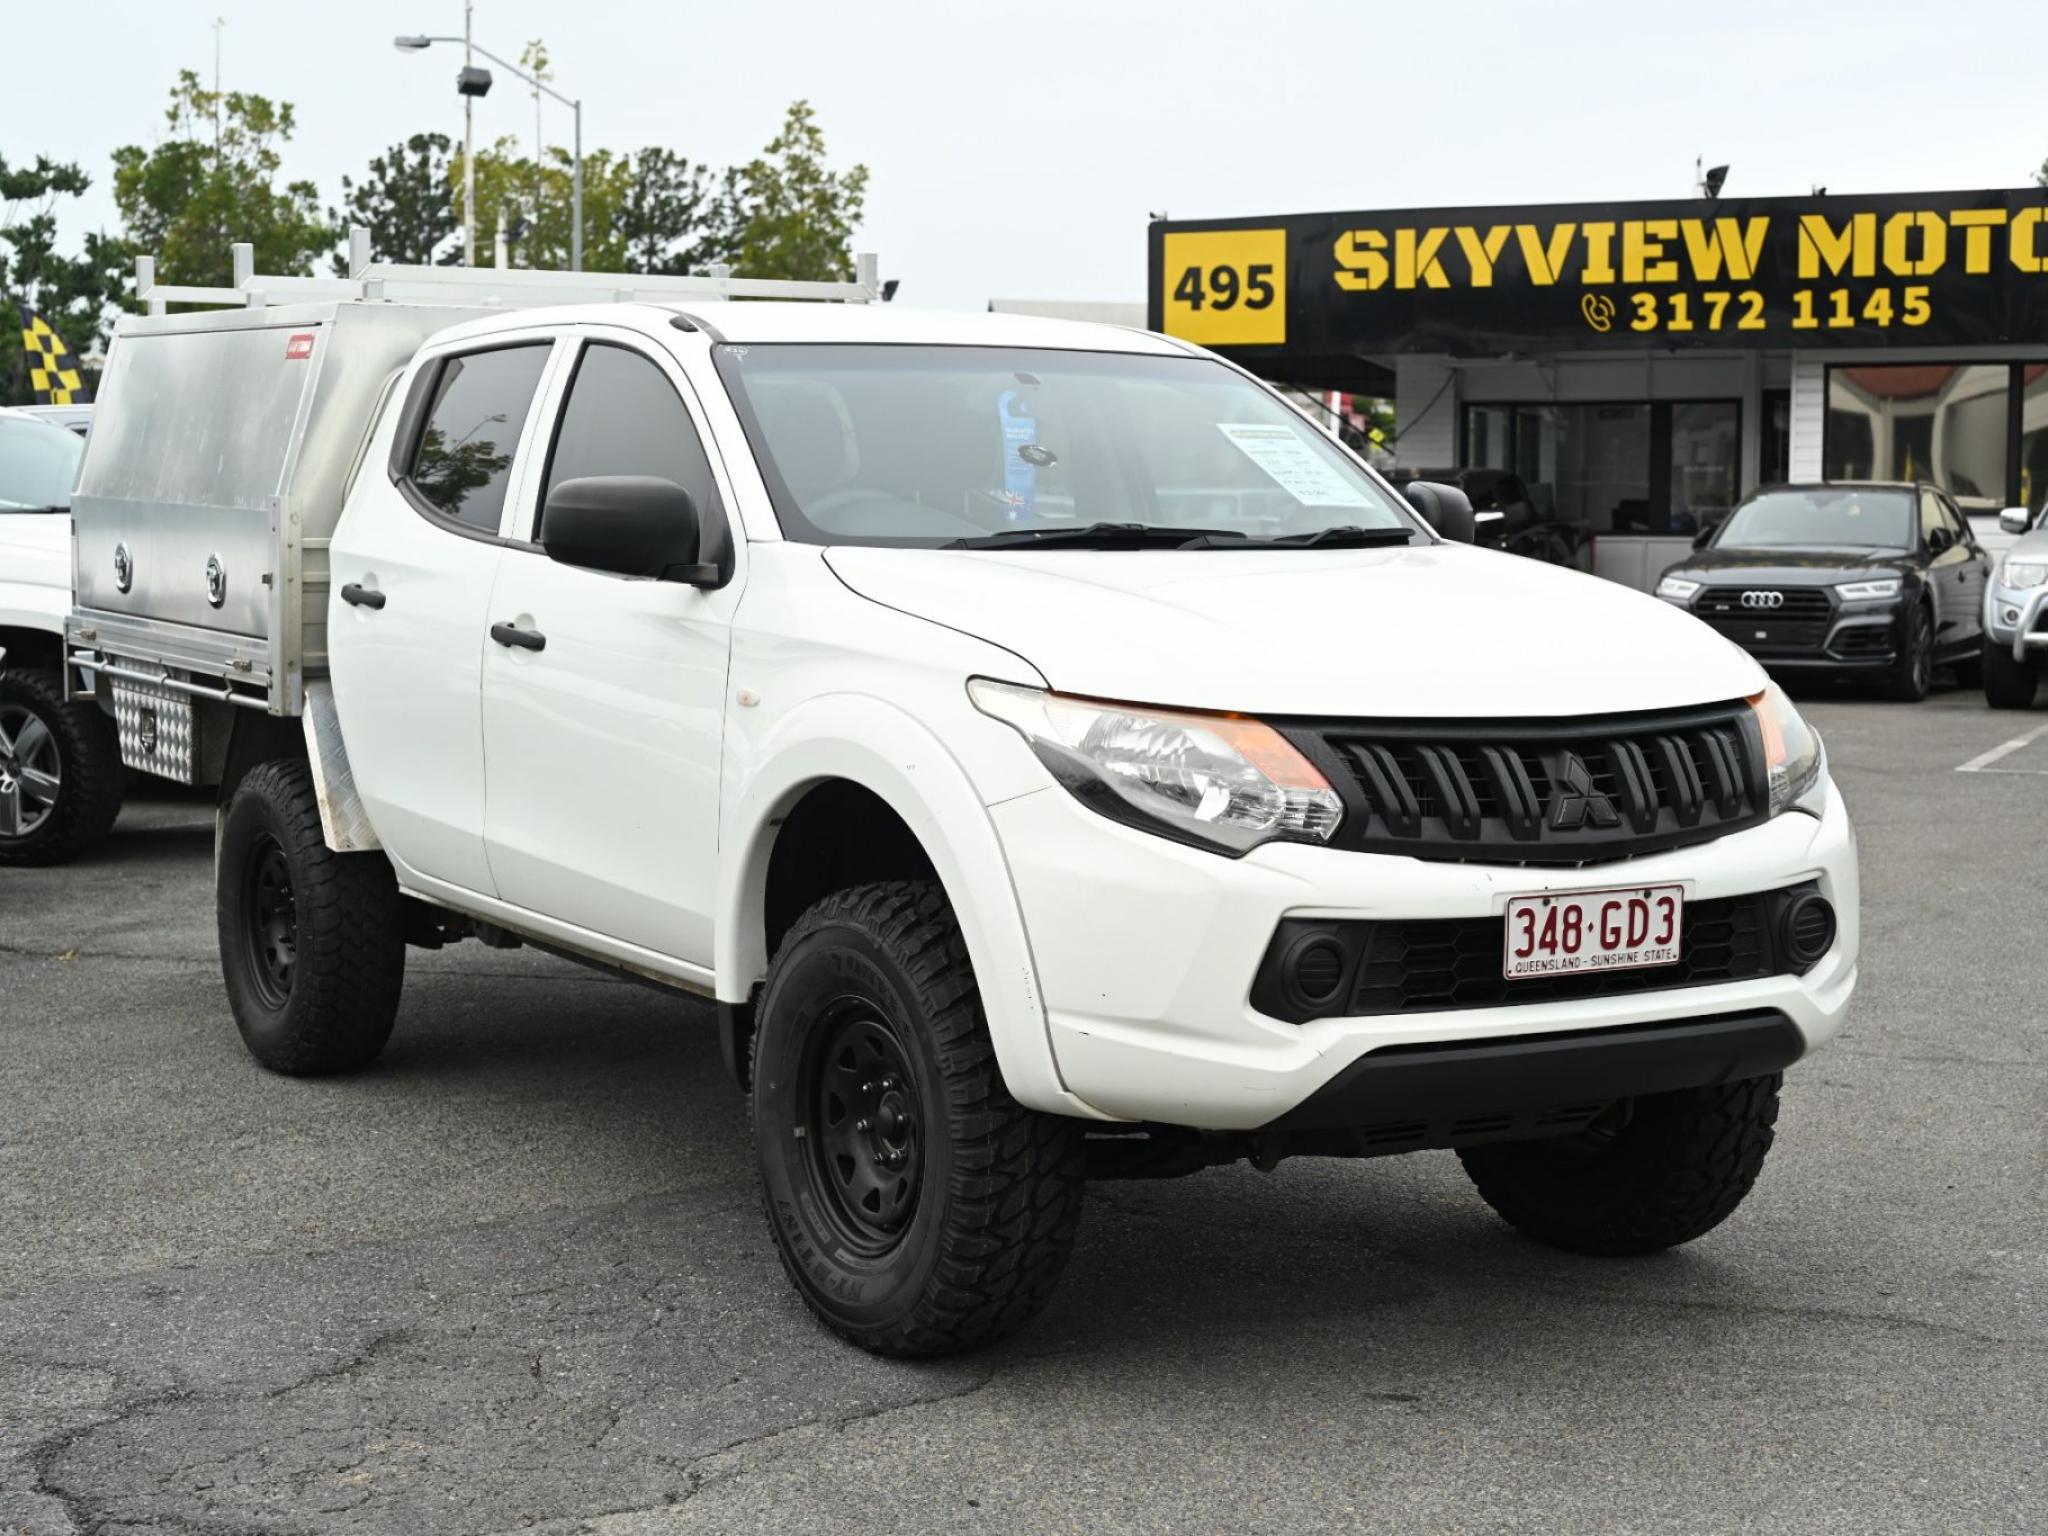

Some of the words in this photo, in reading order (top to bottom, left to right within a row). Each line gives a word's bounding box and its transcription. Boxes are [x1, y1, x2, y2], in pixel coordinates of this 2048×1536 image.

[1334, 216, 1770, 290] SKYVIEW
[1798, 207, 2048, 278] MOTO
[1173, 264, 1275, 311] 495
[1630, 290, 1766, 331] 3172
[1792, 286, 1931, 328] 1145
[1515, 904, 1583, 958] 348
[1600, 896, 1675, 950] GD3
[1515, 956, 1581, 973] QUEENSLAND
[1590, 951, 1639, 967] SUNSHINE
[1644, 948, 1672, 962] STATE
